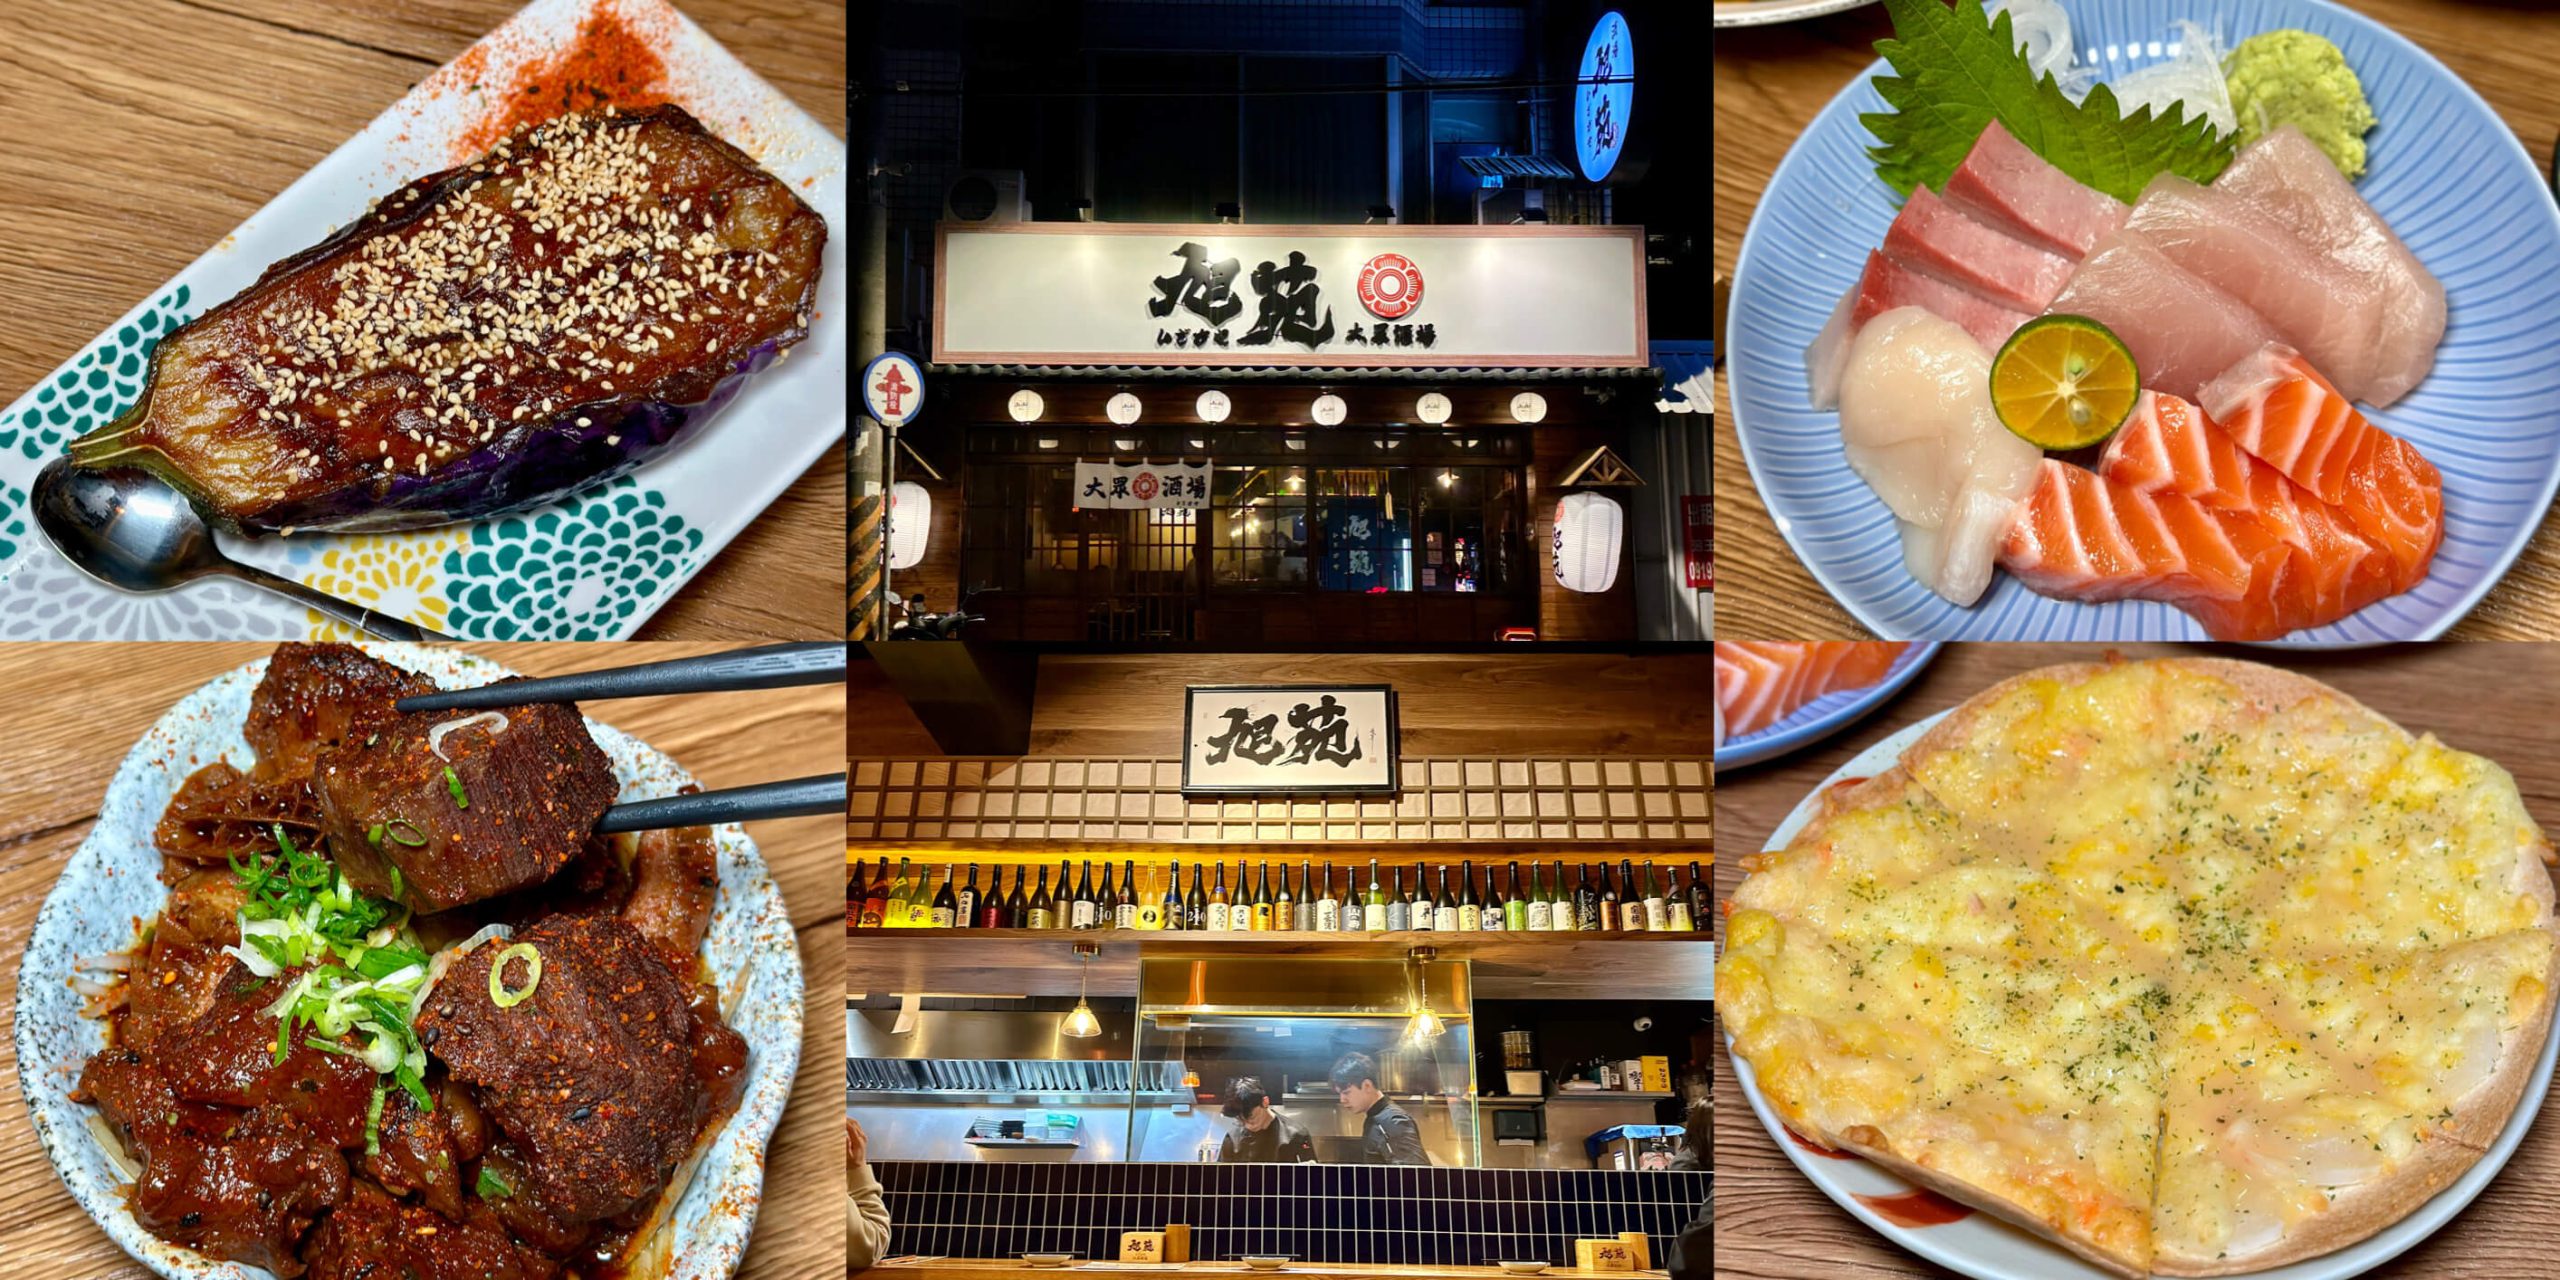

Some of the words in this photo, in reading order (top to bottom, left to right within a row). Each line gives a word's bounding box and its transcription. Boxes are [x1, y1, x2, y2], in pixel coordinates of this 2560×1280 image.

[1148, 241, 1335, 348] 旭苑
[1083, 476, 1130, 499] 大眾
[1162, 475, 1206, 499] 酒場
[1204, 694, 1363, 768] 旭苑
